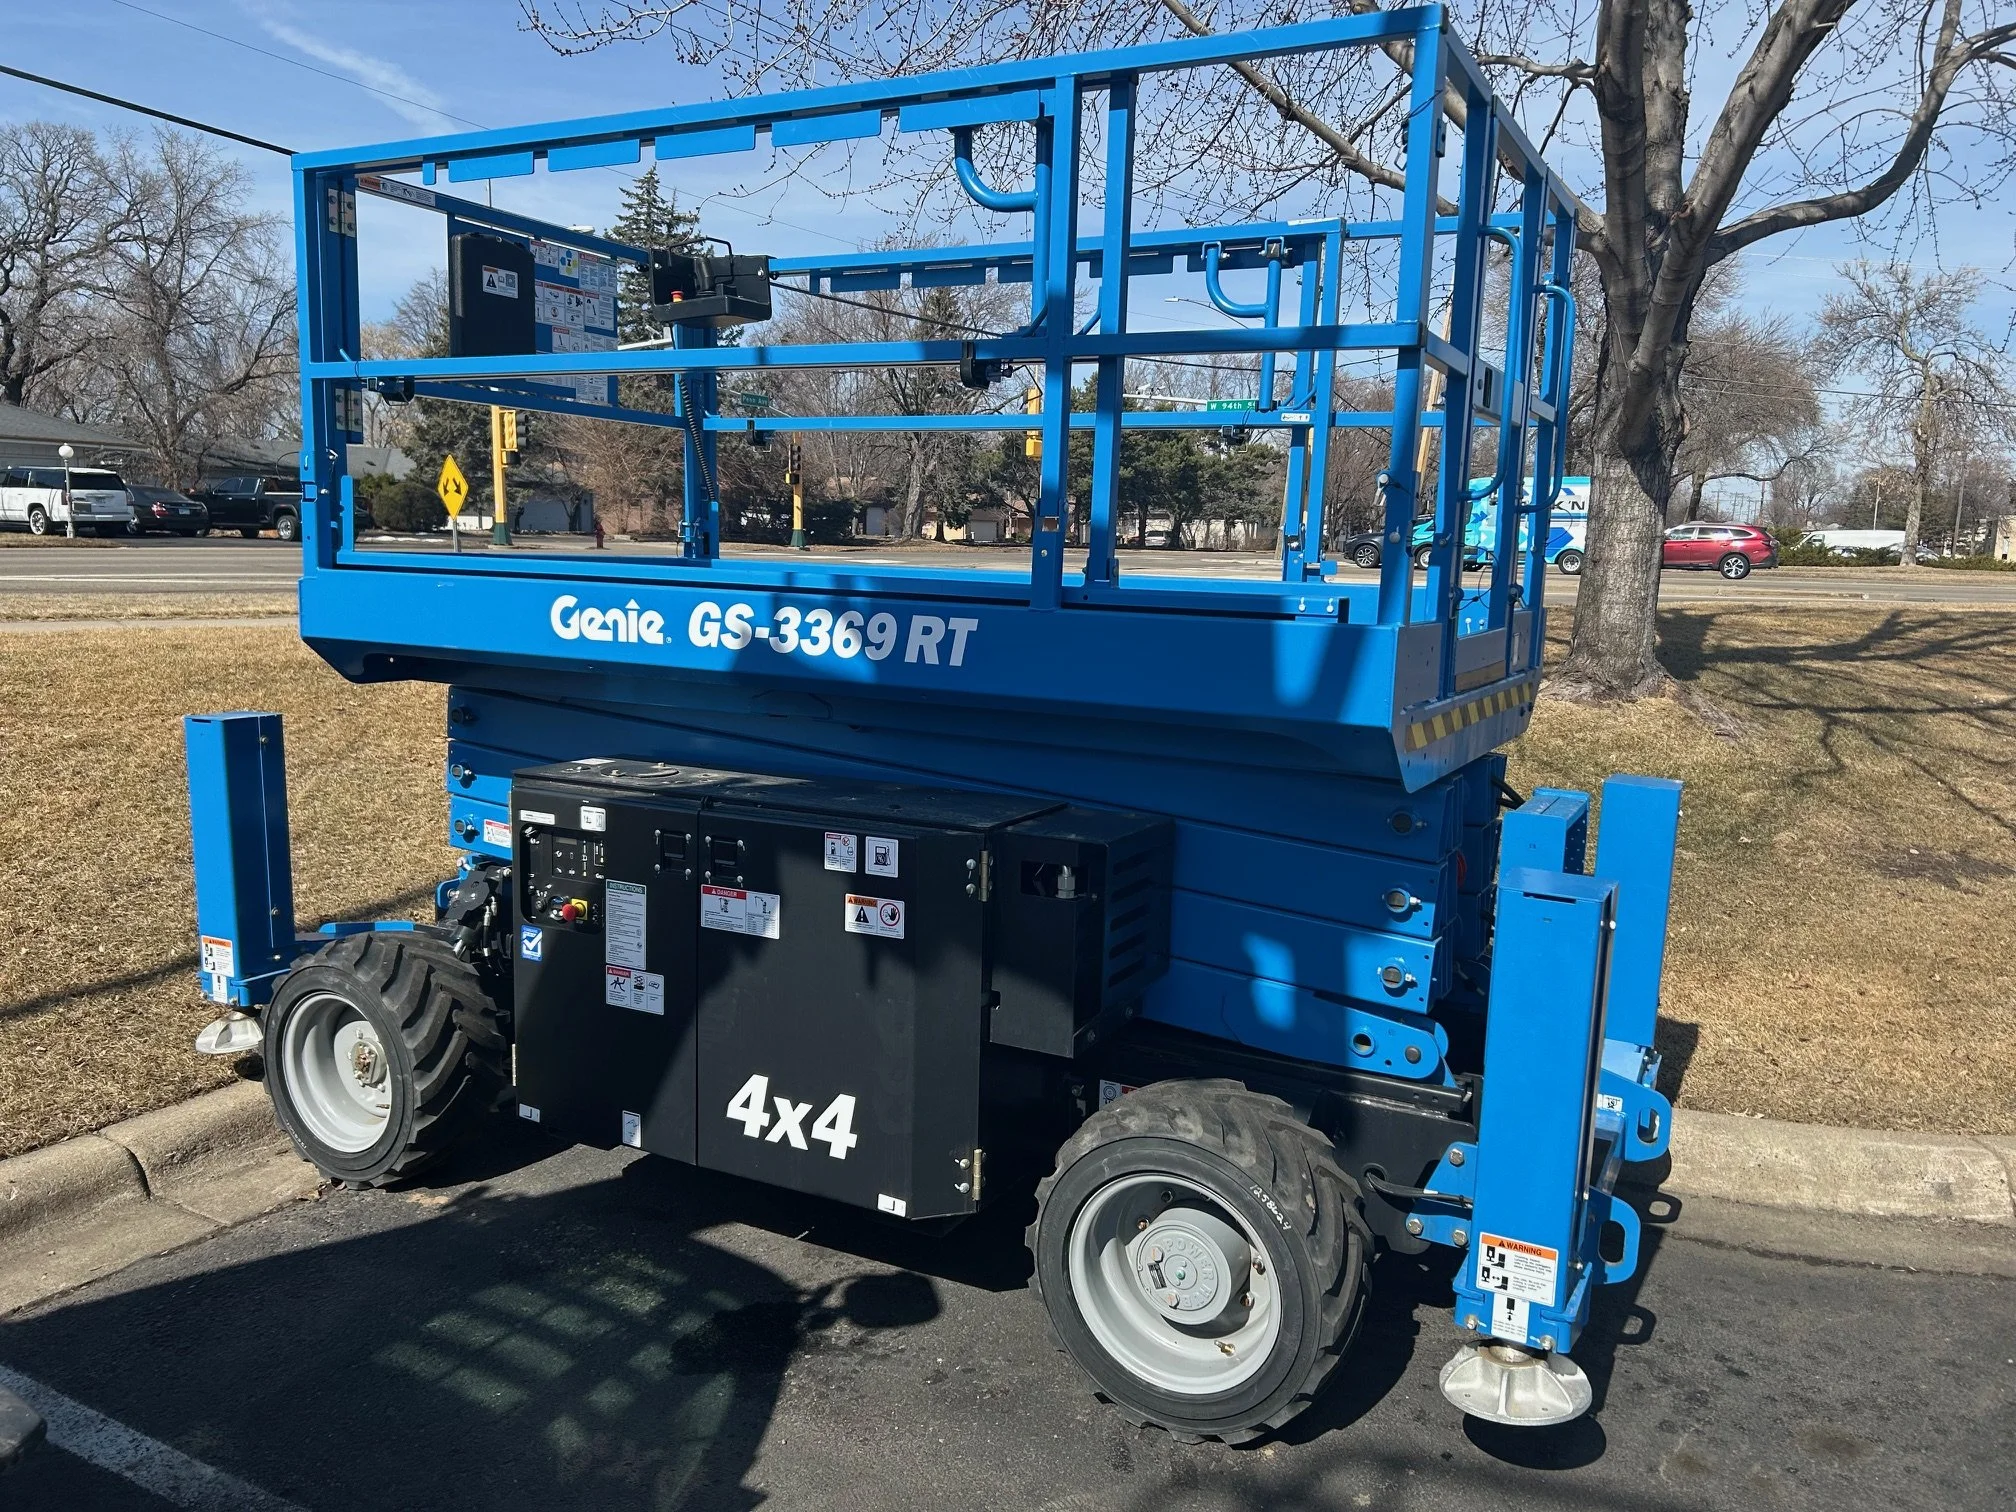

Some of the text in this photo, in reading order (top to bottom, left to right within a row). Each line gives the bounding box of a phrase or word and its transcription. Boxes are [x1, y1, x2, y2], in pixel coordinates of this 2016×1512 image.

[1222, 402, 1242, 410] 94th
[551, 595, 664, 645] Genie
[688, 601, 978, 667] GS-3369 RT
[727, 1074, 858, 1160] 4x4
[1163, 1238, 1214, 1308] POWER HUB
[1506, 1241, 1542, 1256] WARNING
